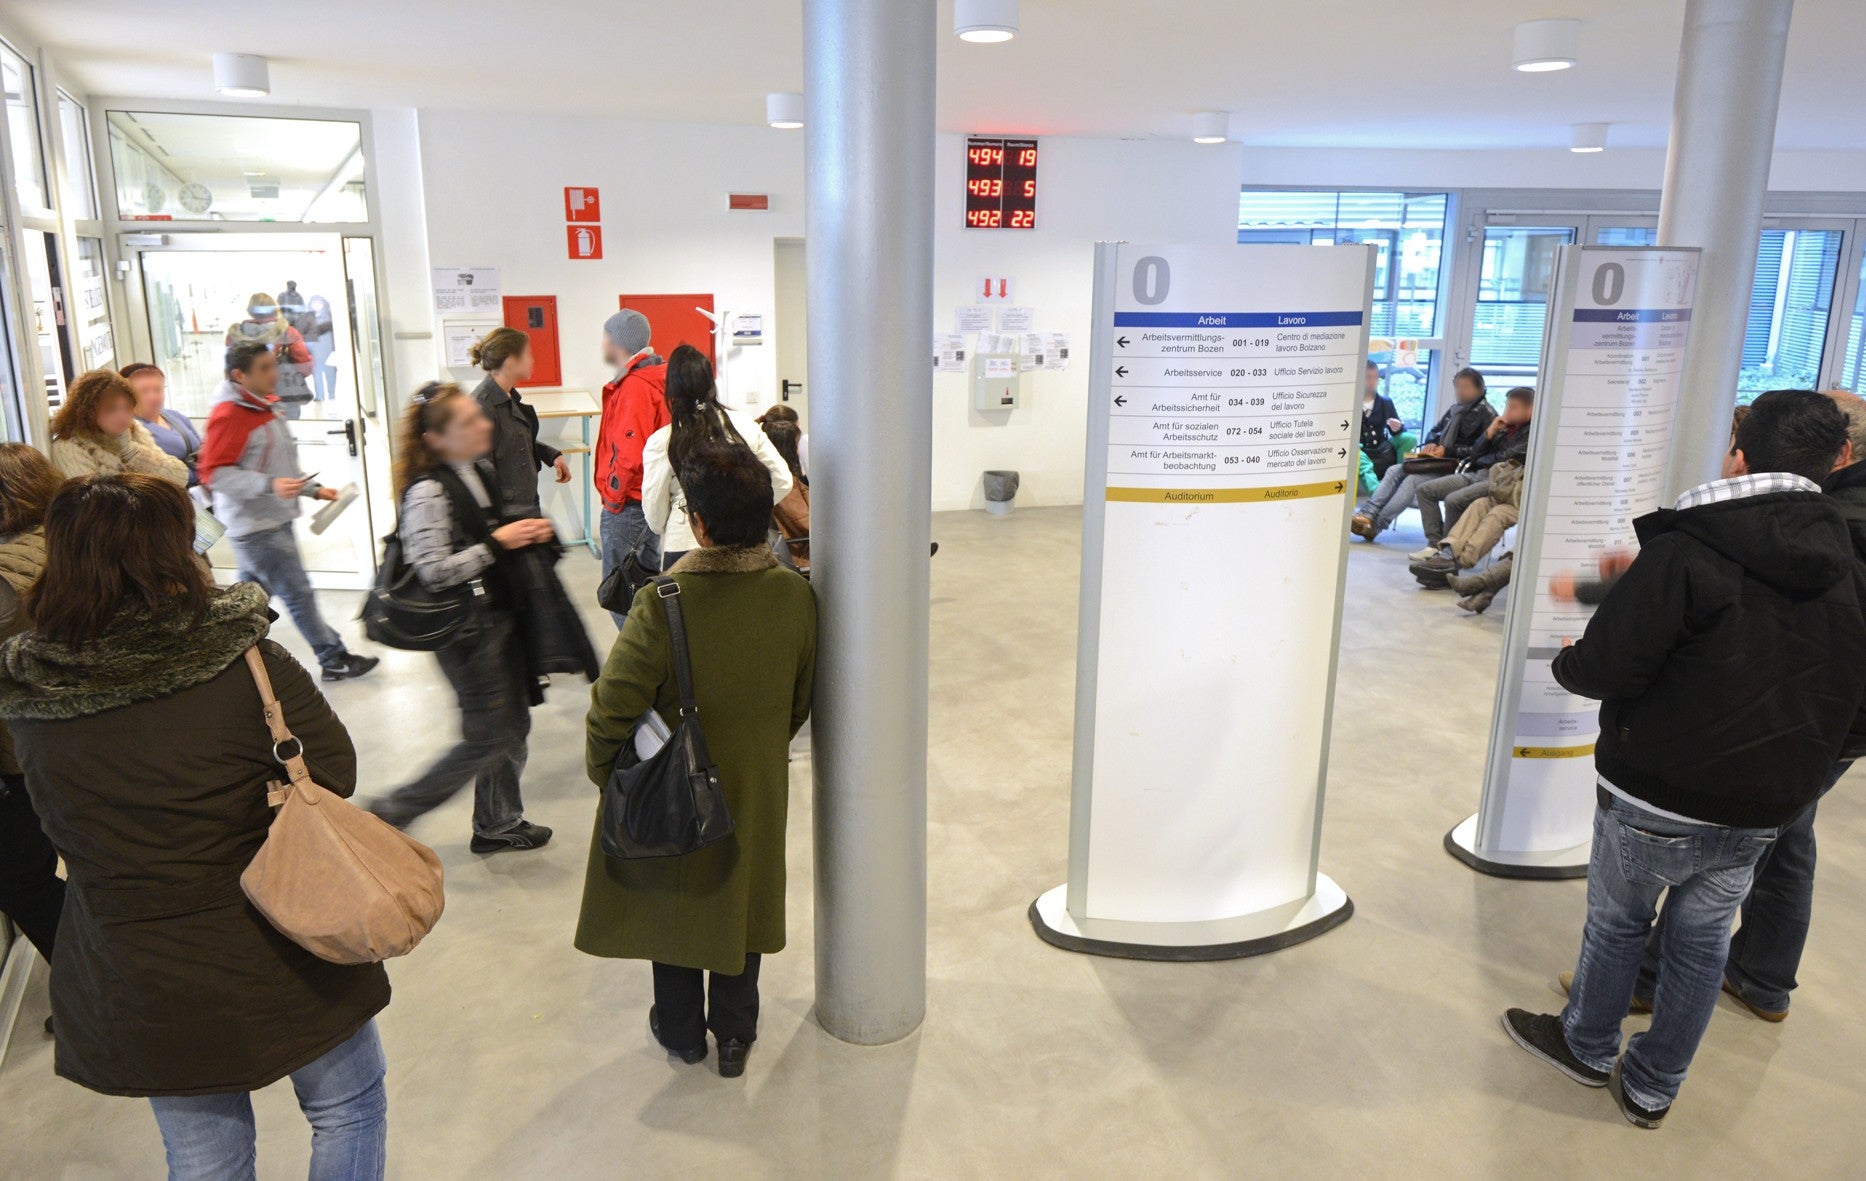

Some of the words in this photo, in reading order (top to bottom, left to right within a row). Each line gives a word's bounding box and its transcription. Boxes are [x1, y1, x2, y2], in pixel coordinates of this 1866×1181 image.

[969, 148, 1003, 165] 494
[1019, 149, 1036, 166] 19
[968, 179, 1002, 196] 493
[1023, 180, 1035, 197] 5
[967, 210, 1001, 226] 492
[1011, 210, 1034, 227] 22
[1198, 315, 1226, 325] Arbeit
[1278, 316, 1306, 325] Lavoro
[1617, 312, 1640, 320] Arbeit
[1142, 333, 1225, 342] Arbeitsvermittlungs-
[1277, 332, 1300, 340] Centro
[1310, 332, 1345, 340] mediazione
[1233, 339, 1247, 347] 001
[1255, 339, 1269, 347] 019
[1198, 344, 1224, 352] Bozen
[1276, 344, 1298, 352] lavoro
[1164, 368, 1222, 377] Arbeitsservice
[1230, 369, 1245, 377] 020
[1252, 369, 1267, 377] 033
[1274, 368, 1296, 376] Ufficio
[1325, 366, 1343, 374] lavoro
[1191, 393, 1207, 401] Amt
[1210, 392, 1221, 401] für
[1272, 392, 1294, 400] Ufficio
[1296, 390, 1327, 399] Sicurezza
[1228, 398, 1243, 406] 034
[1250, 398, 1264, 406] 039
[1285, 402, 1304, 410] lavoro
[1152, 403, 1220, 412] Arbeitssicherheit
[1153, 422, 1169, 430] Amt
[1171, 422, 1183, 430] für
[1185, 423, 1218, 431] sozialen
[1270, 421, 1292, 429] Ufficio
[1294, 420, 1314, 428] Tutela
[1226, 428, 1241, 436] 072
[1248, 427, 1263, 436] 054
[1269, 432, 1293, 440] sociale
[1306, 429, 1326, 437] lavoro
[1163, 432, 1218, 441] Arbeitsschutz
[1131, 450, 1148, 458] Amt
[1150, 450, 1161, 459] für
[1162, 451, 1216, 460] Arbeitsmarkt-
[1268, 449, 1290, 458] Ufficio
[1292, 446, 1333, 456] Osservazione
[1224, 456, 1239, 464] 053
[1246, 456, 1260, 464] 040
[1267, 459, 1294, 468] mercato
[1296, 458, 1306, 466] del
[1308, 457, 1326, 465] lavoro
[1164, 462, 1216, 471] beobachtung
[1165, 492, 1214, 501] Auditorium
[1264, 488, 1298, 499] Auditorio
